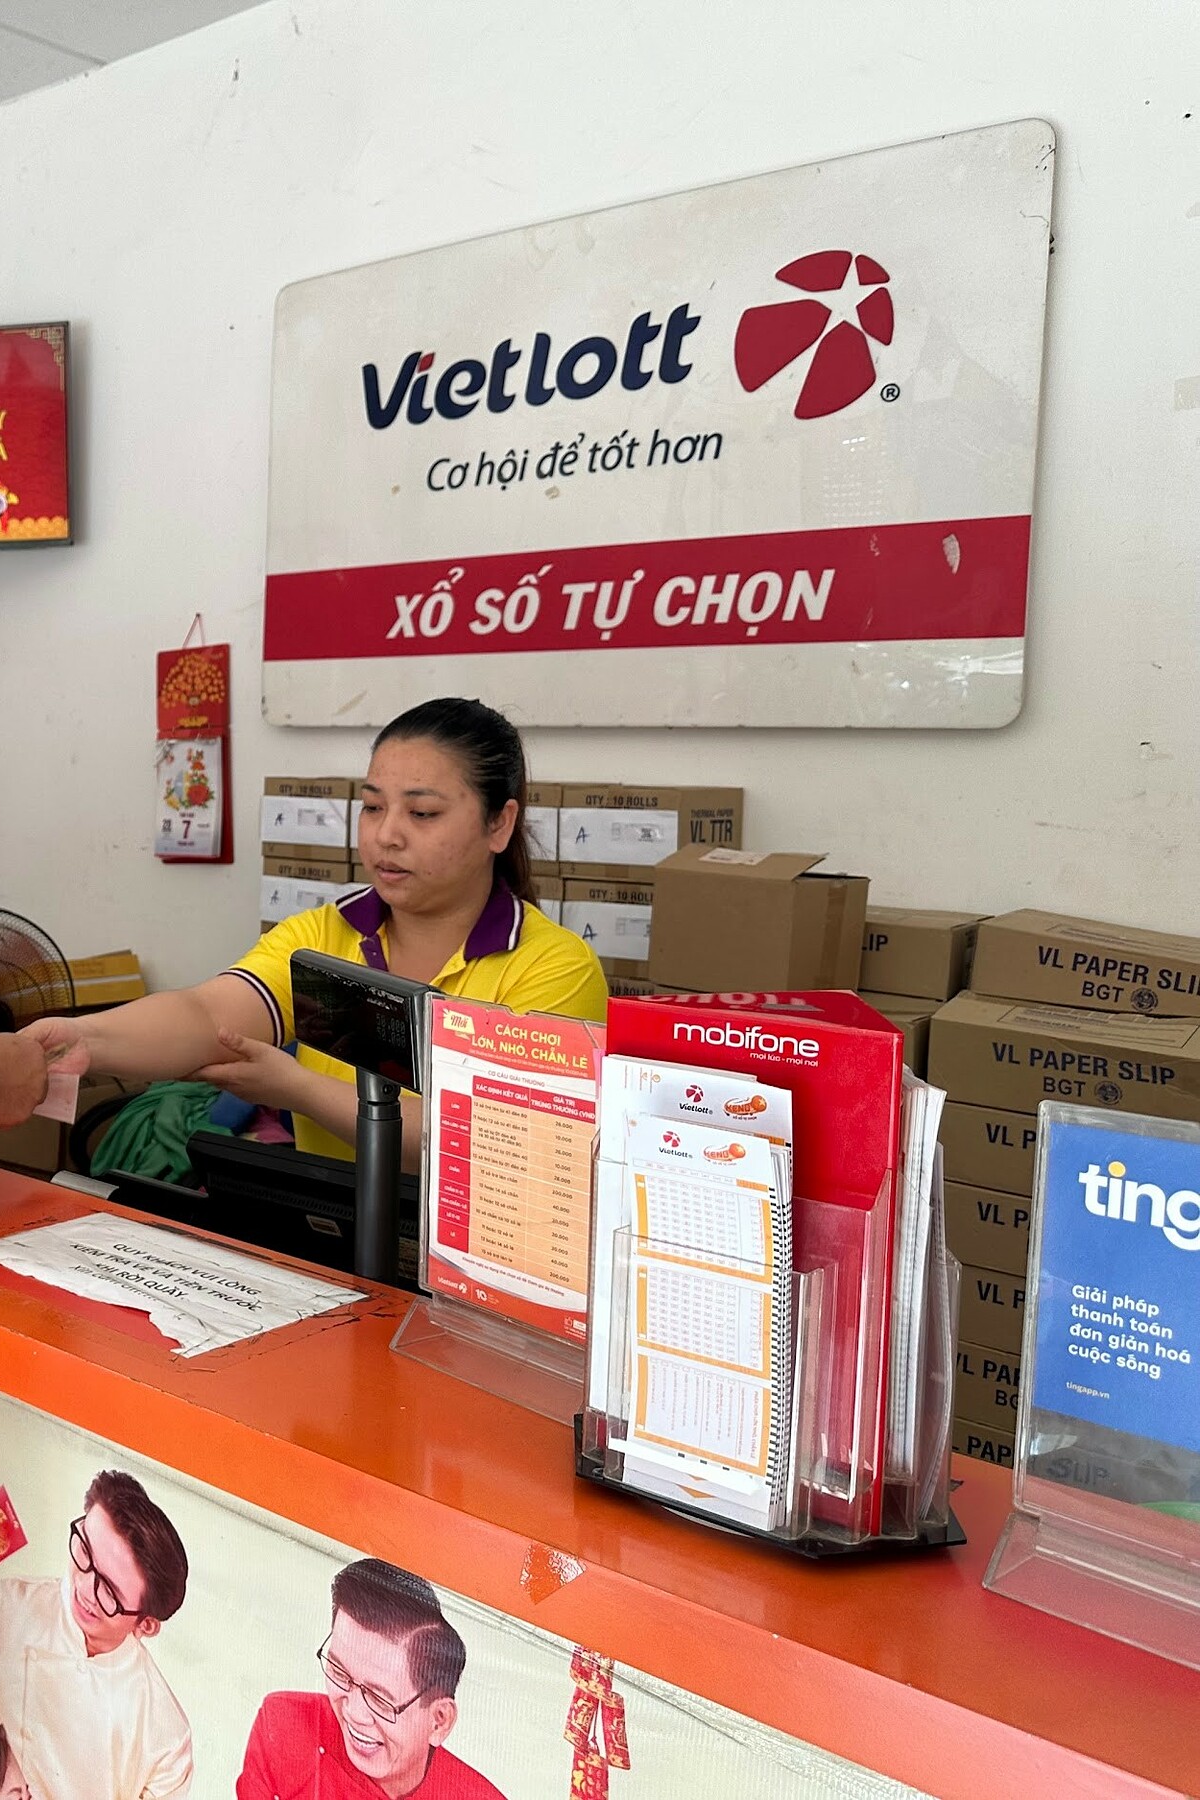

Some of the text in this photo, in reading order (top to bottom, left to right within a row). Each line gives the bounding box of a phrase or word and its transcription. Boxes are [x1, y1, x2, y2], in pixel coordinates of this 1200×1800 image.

[362, 303, 700, 429] Vietlott
[426, 429, 723, 491] Cơ hội để tốt hơn
[386, 564, 835, 641] XỔ SỐ TỰ CHỌN
[586, 796, 603, 807] QTY
[626, 797, 658, 807] ROLLS
[182, 820, 190, 839] 7
[575, 826, 590, 844] A
[690, 819, 732, 843] VL TTR
[589, 889, 608, 898] QTY
[1038, 946, 1200, 996] VL PAPER SLI
[1081, 981, 1125, 1003] BGT
[495, 1023, 561, 1047] CÁCH CHƠI
[674, 1022, 820, 1058] mobifone
[472, 1033, 496, 1052] LỚN,
[499, 1041, 528, 1059] NHỎ,
[531, 1045, 570, 1067] CHẴN,
[572, 1054, 588, 1069] LẺ
[992, 1042, 1176, 1086] VL PAPER SLIP
[1043, 1076, 1087, 1098] BGT
[680, 1102, 709, 1115] Vietlott
[986, 1123, 1014, 1147] VL
[659, 1147, 688, 1158] Vietlott
[977, 1201, 1005, 1225] VL
[1079, 1160, 1200, 1252] ting
[191, 1269, 220, 1281] VUI
[976, 1280, 1005, 1306] VL
[1072, 1285, 1160, 1318] Giải pháp
[1071, 1304, 1173, 1339] thanh toán
[1070, 1323, 1191, 1364] đơn giản hoá
[1068, 1344, 1161, 1380] cuộc sống
[1066, 1381, 1110, 1399] tingapp.vn
